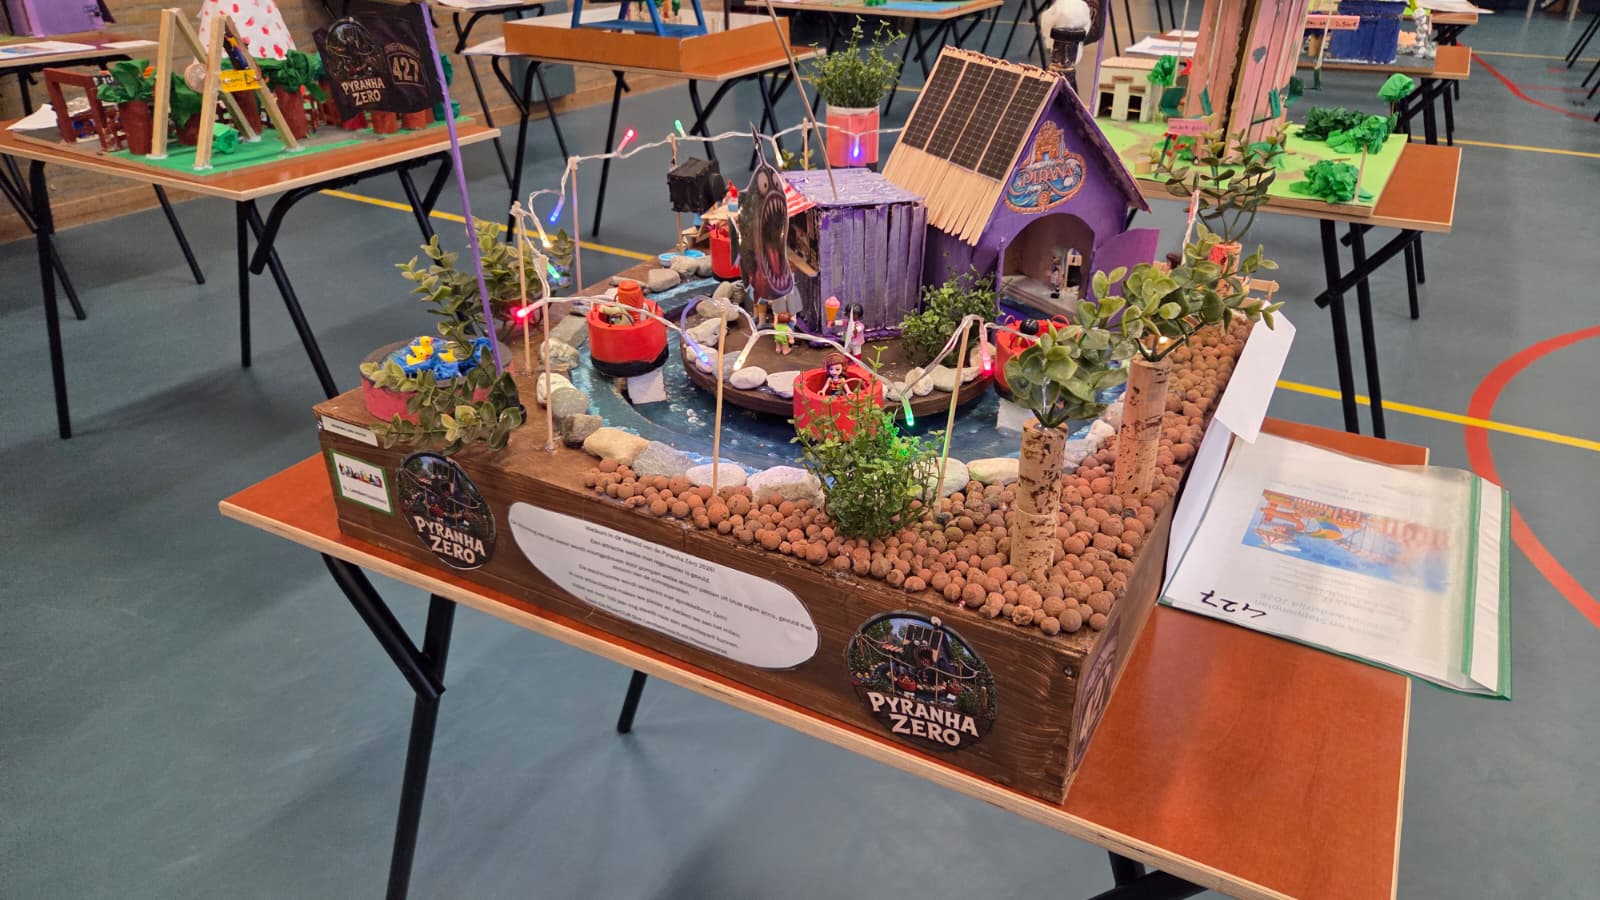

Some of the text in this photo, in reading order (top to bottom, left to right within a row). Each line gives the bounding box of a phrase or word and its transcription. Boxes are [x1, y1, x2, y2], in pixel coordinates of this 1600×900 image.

[392, 56, 419, 83] 427
[341, 77, 386, 96] PYRANHA
[352, 89, 381, 107] ZERO
[414, 515, 487, 557] PYRANHA
[429, 534, 476, 564] ZERO
[1200, 590, 1267, 618] 427
[867, 691, 980, 738] PYRANHA
[888, 713, 961, 747] ZERO
